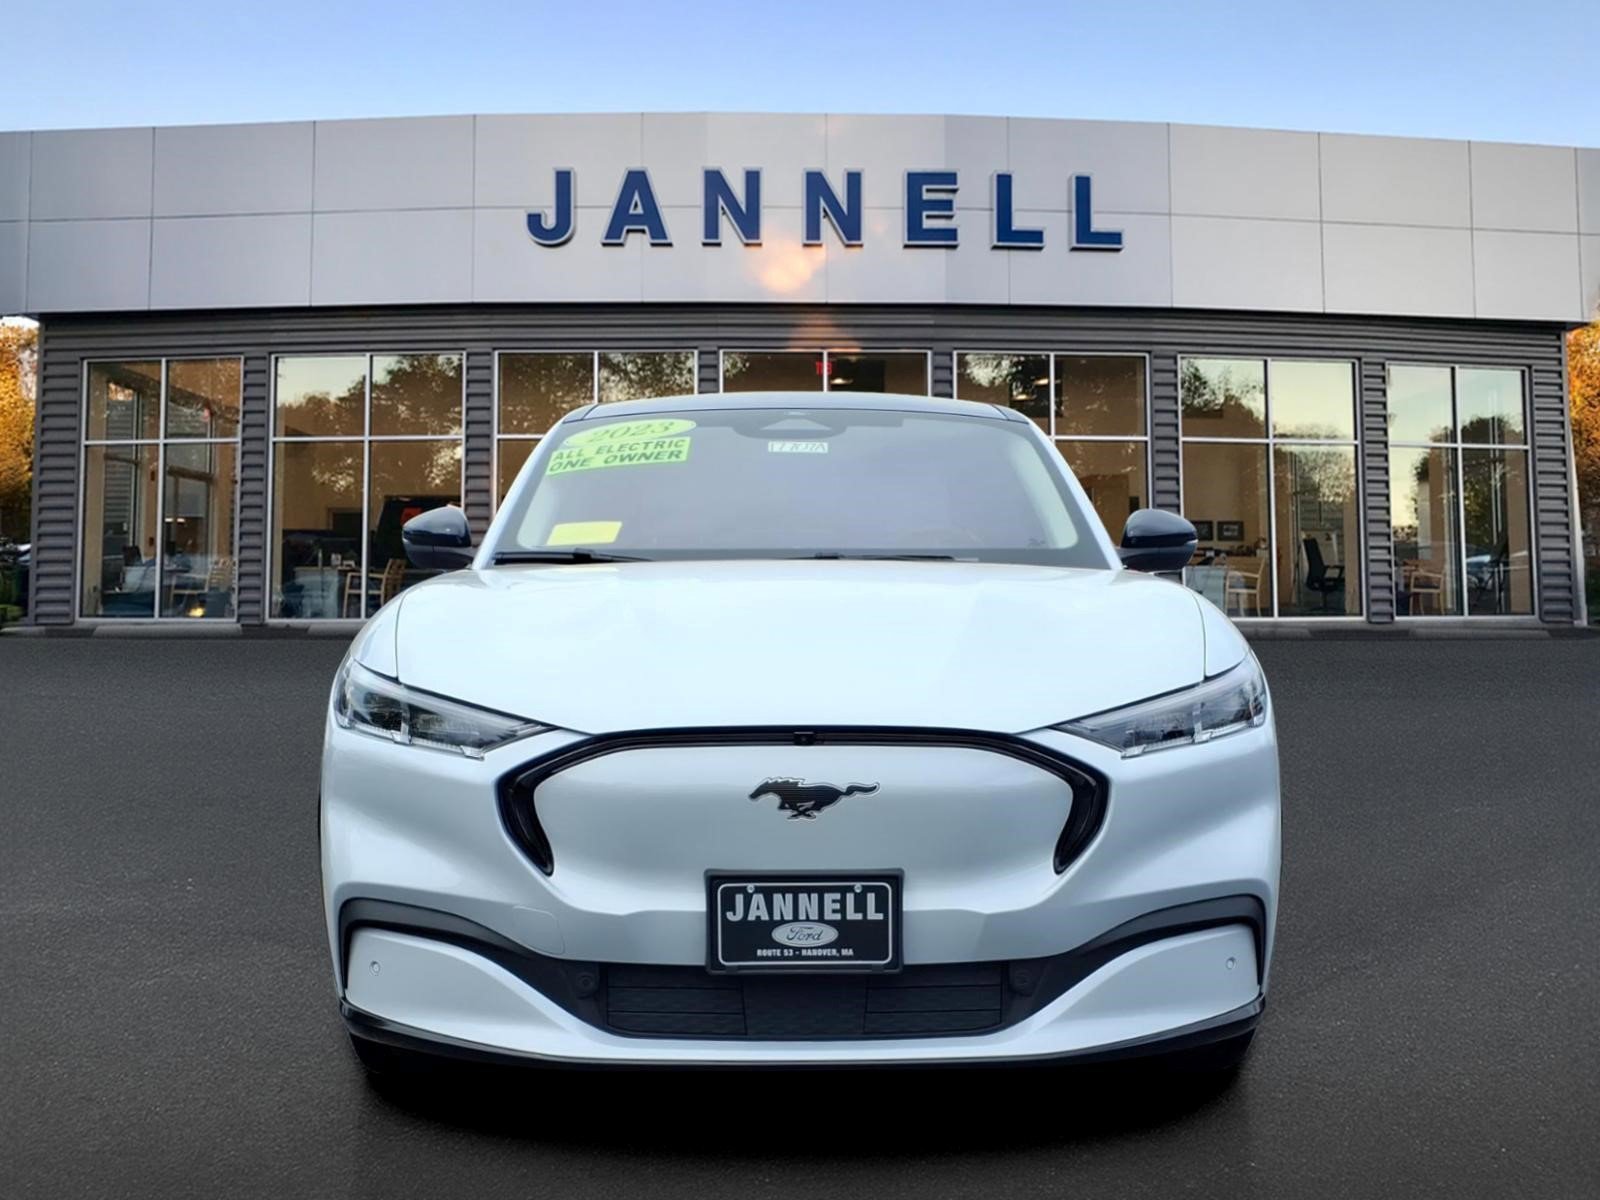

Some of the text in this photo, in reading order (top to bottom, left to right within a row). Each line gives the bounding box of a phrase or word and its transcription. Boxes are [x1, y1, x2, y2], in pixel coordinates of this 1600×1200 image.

[526, 166, 1124, 250] JANNELL
[587, 421, 675, 442] 2023
[549, 449, 683, 472] ONE OWNER
[552, 439, 686, 461] ALL ELECTRIC
[726, 892, 884, 922] JANNELL
[786, 925, 823, 941] Ford
[756, 948, 782, 957] ROUTE
[783, 948, 794, 957] 53
[801, 948, 840, 957] HANOVER,
[841, 948, 854, 957] MA
